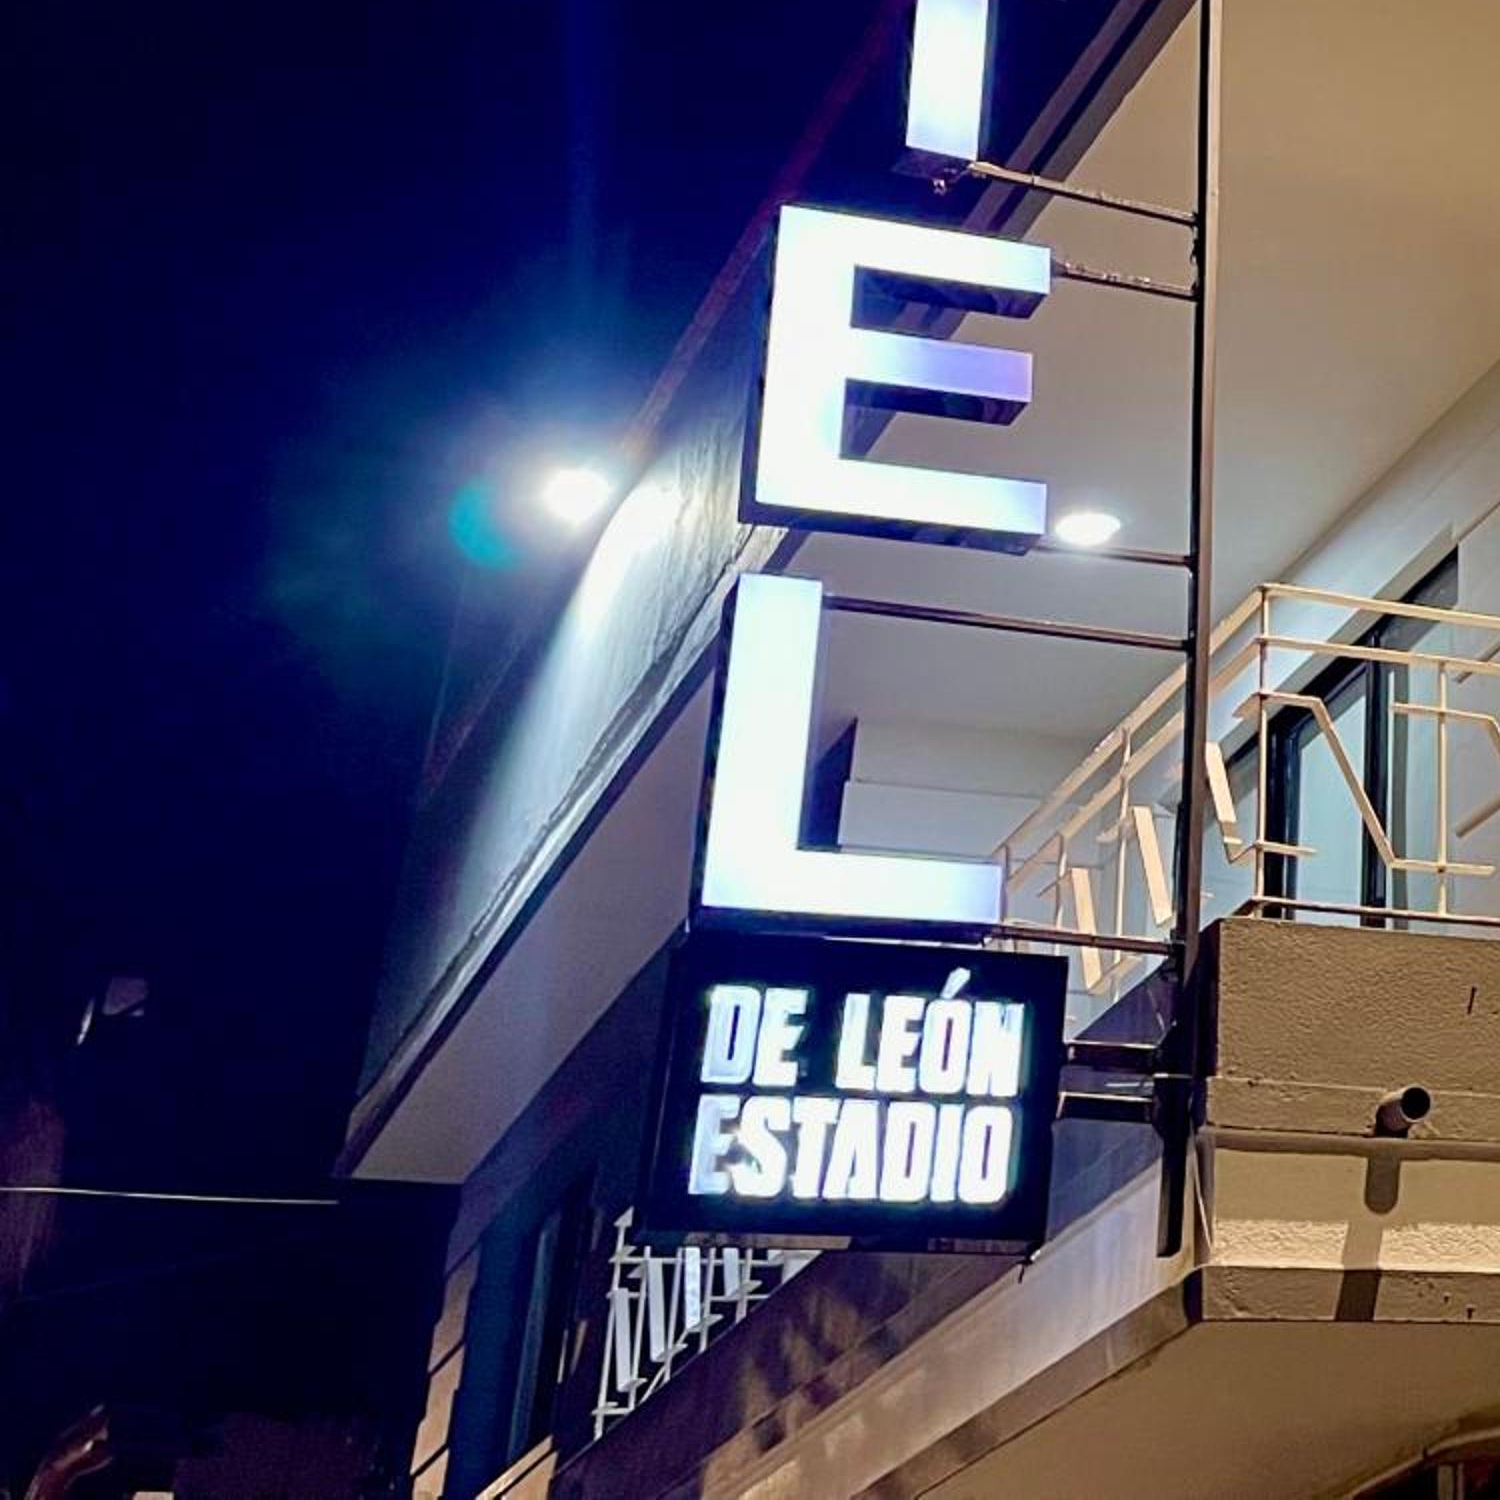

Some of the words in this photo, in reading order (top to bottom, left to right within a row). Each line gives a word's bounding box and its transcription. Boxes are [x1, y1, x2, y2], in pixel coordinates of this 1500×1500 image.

[701, 985, 808, 1087] DE
[835, 968, 1026, 1095] LEÓN
[689, 1095, 1014, 1204] ESTADIO
